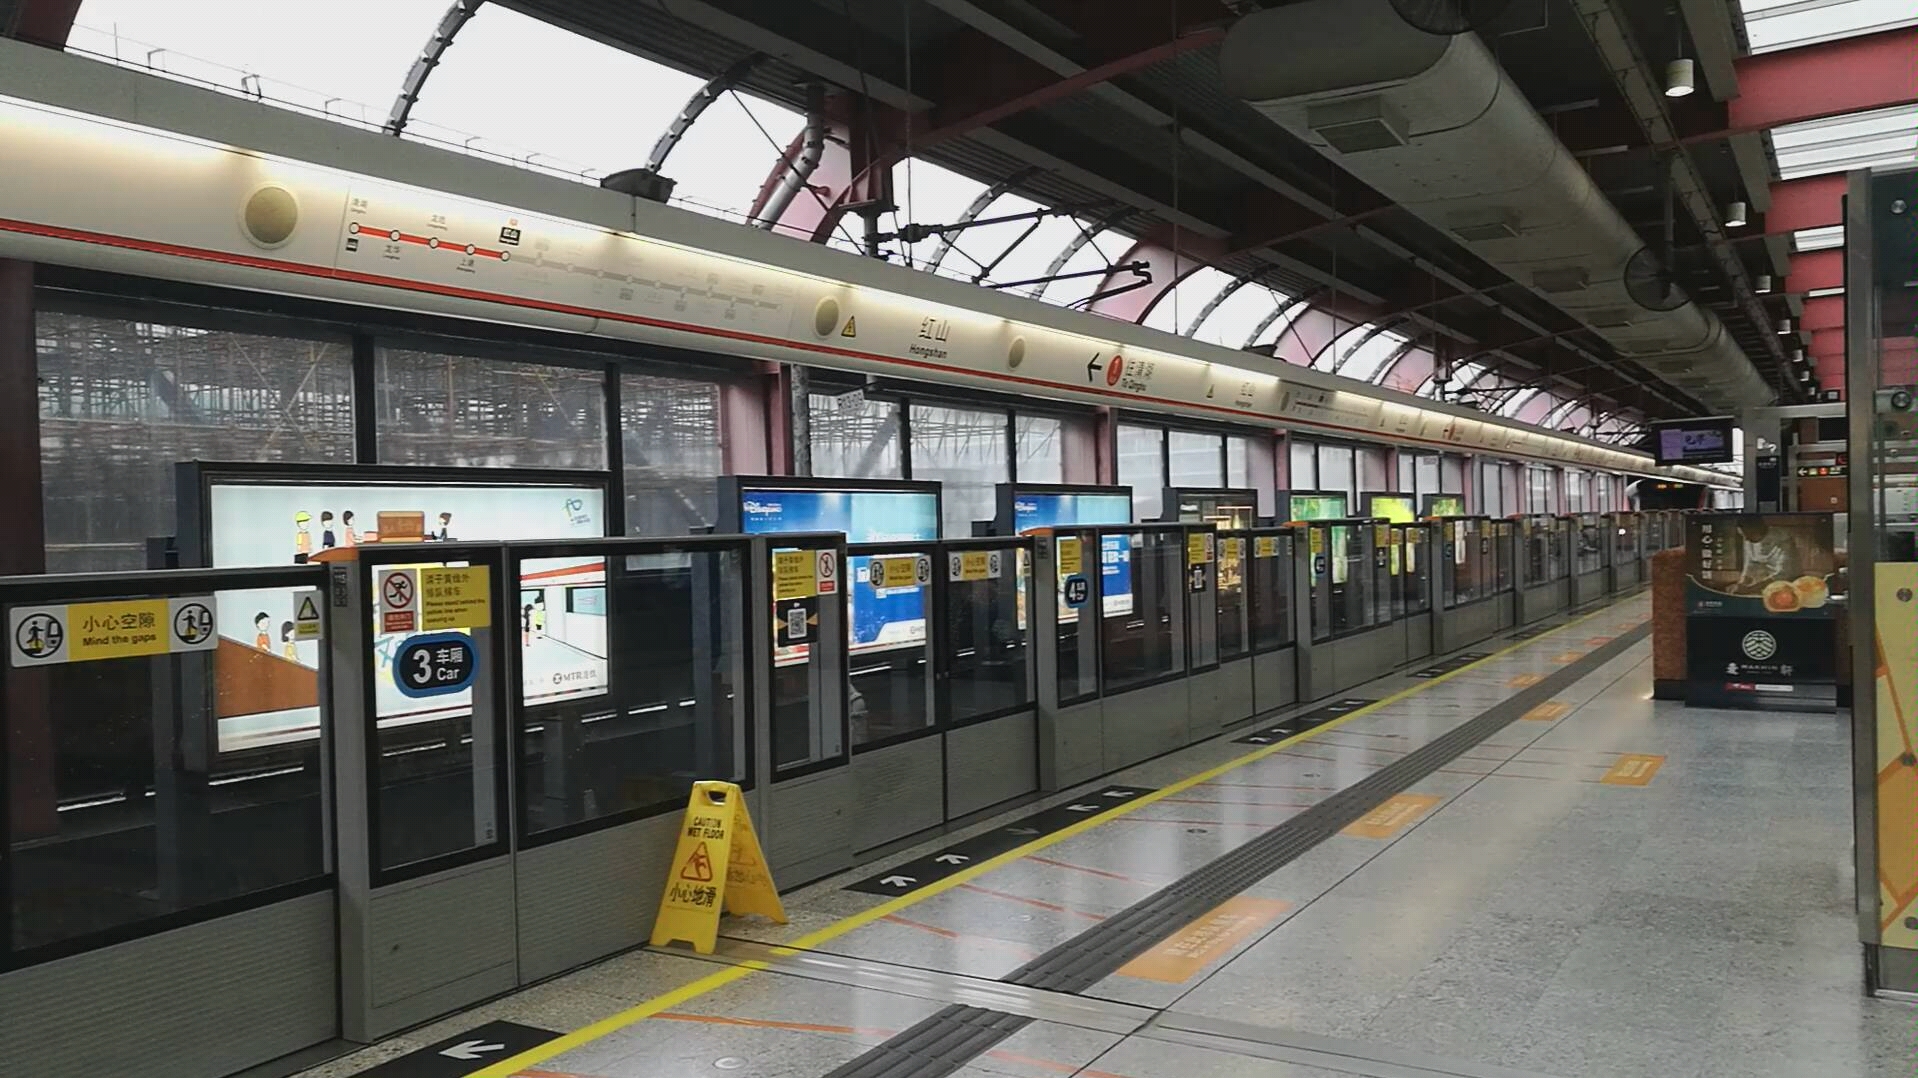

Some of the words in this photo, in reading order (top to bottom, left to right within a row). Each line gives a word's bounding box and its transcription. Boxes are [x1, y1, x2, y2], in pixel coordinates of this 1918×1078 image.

[918, 316, 951, 341] 红山
[909, 343, 948, 359] Hongshan
[1069, 582, 1076, 601] 4
[82, 611, 156, 633] 小心空隙
[83, 636, 110, 647] Mind
[112, 635, 129, 645] the
[131, 634, 157, 645] gaps
[435, 647, 463, 664] 车厢
[413, 649, 432, 684] 3
[436, 667, 460, 681] Car
[693, 816, 722, 828] CAUTION
[687, 827, 702, 838] WET
[703, 828, 724, 840] FLOOR
[670, 882, 717, 907] 小心地滑
